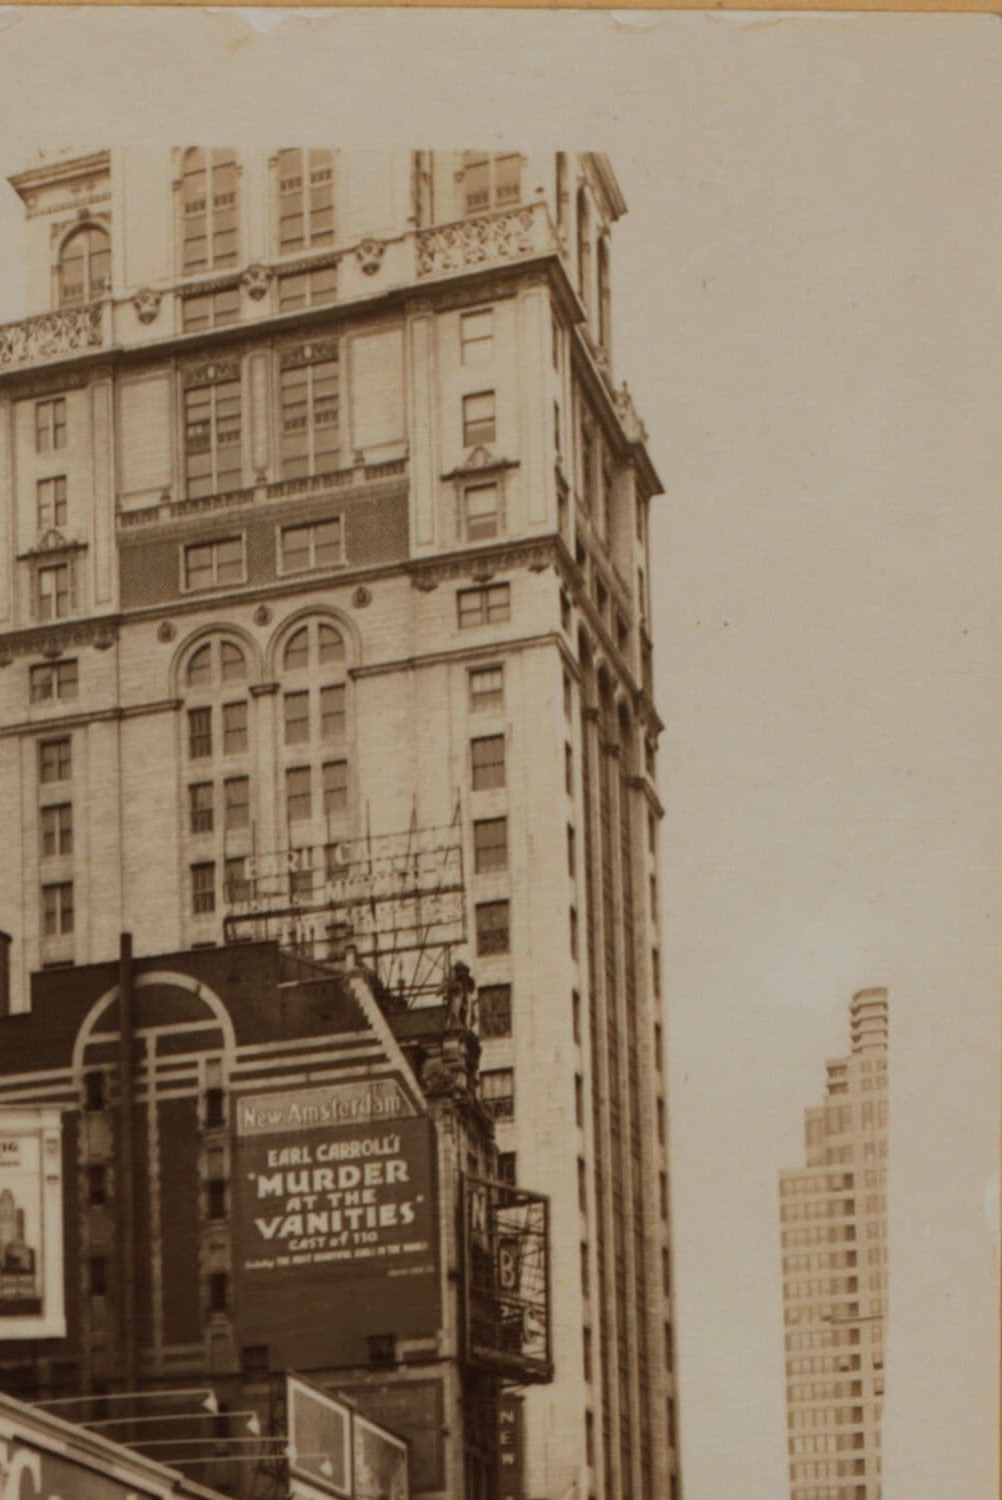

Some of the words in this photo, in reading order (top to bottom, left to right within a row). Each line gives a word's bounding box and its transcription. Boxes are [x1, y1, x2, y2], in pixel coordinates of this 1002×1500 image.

[245, 1106, 282, 1128] New
[288, 1092, 400, 1122] Amsterdam
[267, 1145, 312, 1168] EARL
[316, 1134, 400, 1161] CARROLL'S
[285, 1195, 317, 1212] AT
[327, 1189, 376, 1208] THE
[289, 1236, 326, 1251] CAST
[330, 1231, 347, 1247] of
[353, 1231, 378, 1244] 110
